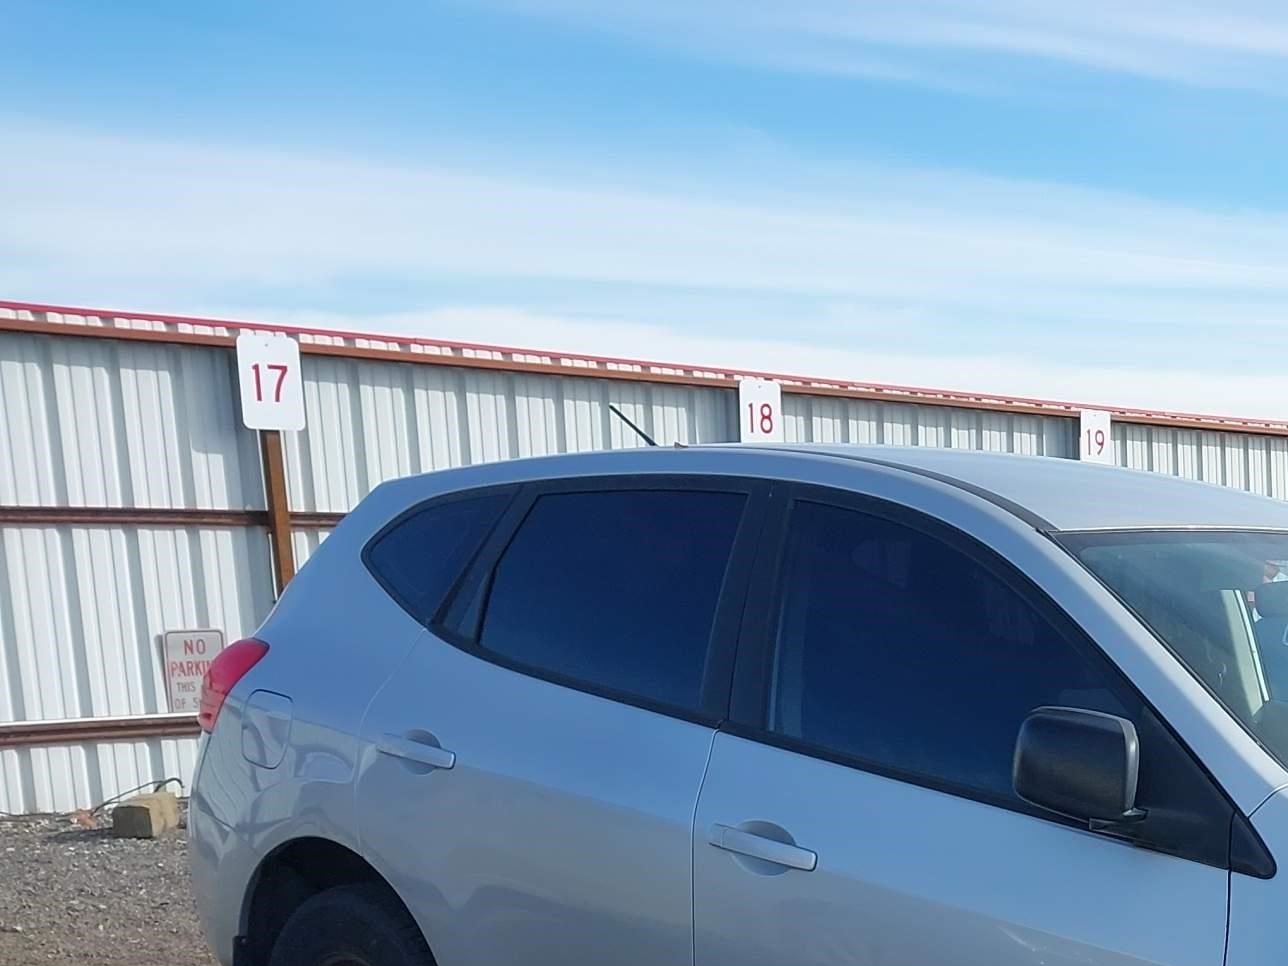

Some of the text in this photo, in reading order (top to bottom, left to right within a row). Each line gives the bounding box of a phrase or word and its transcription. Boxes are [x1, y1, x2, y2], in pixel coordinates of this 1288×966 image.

[251, 362, 289, 403] 17
[747, 402, 774, 434] 18
[1086, 428, 1105, 456] 19
[183, 638, 207, 655] NO
[170, 660, 210, 678] PARKI
[176, 681, 197, 693] THIS
